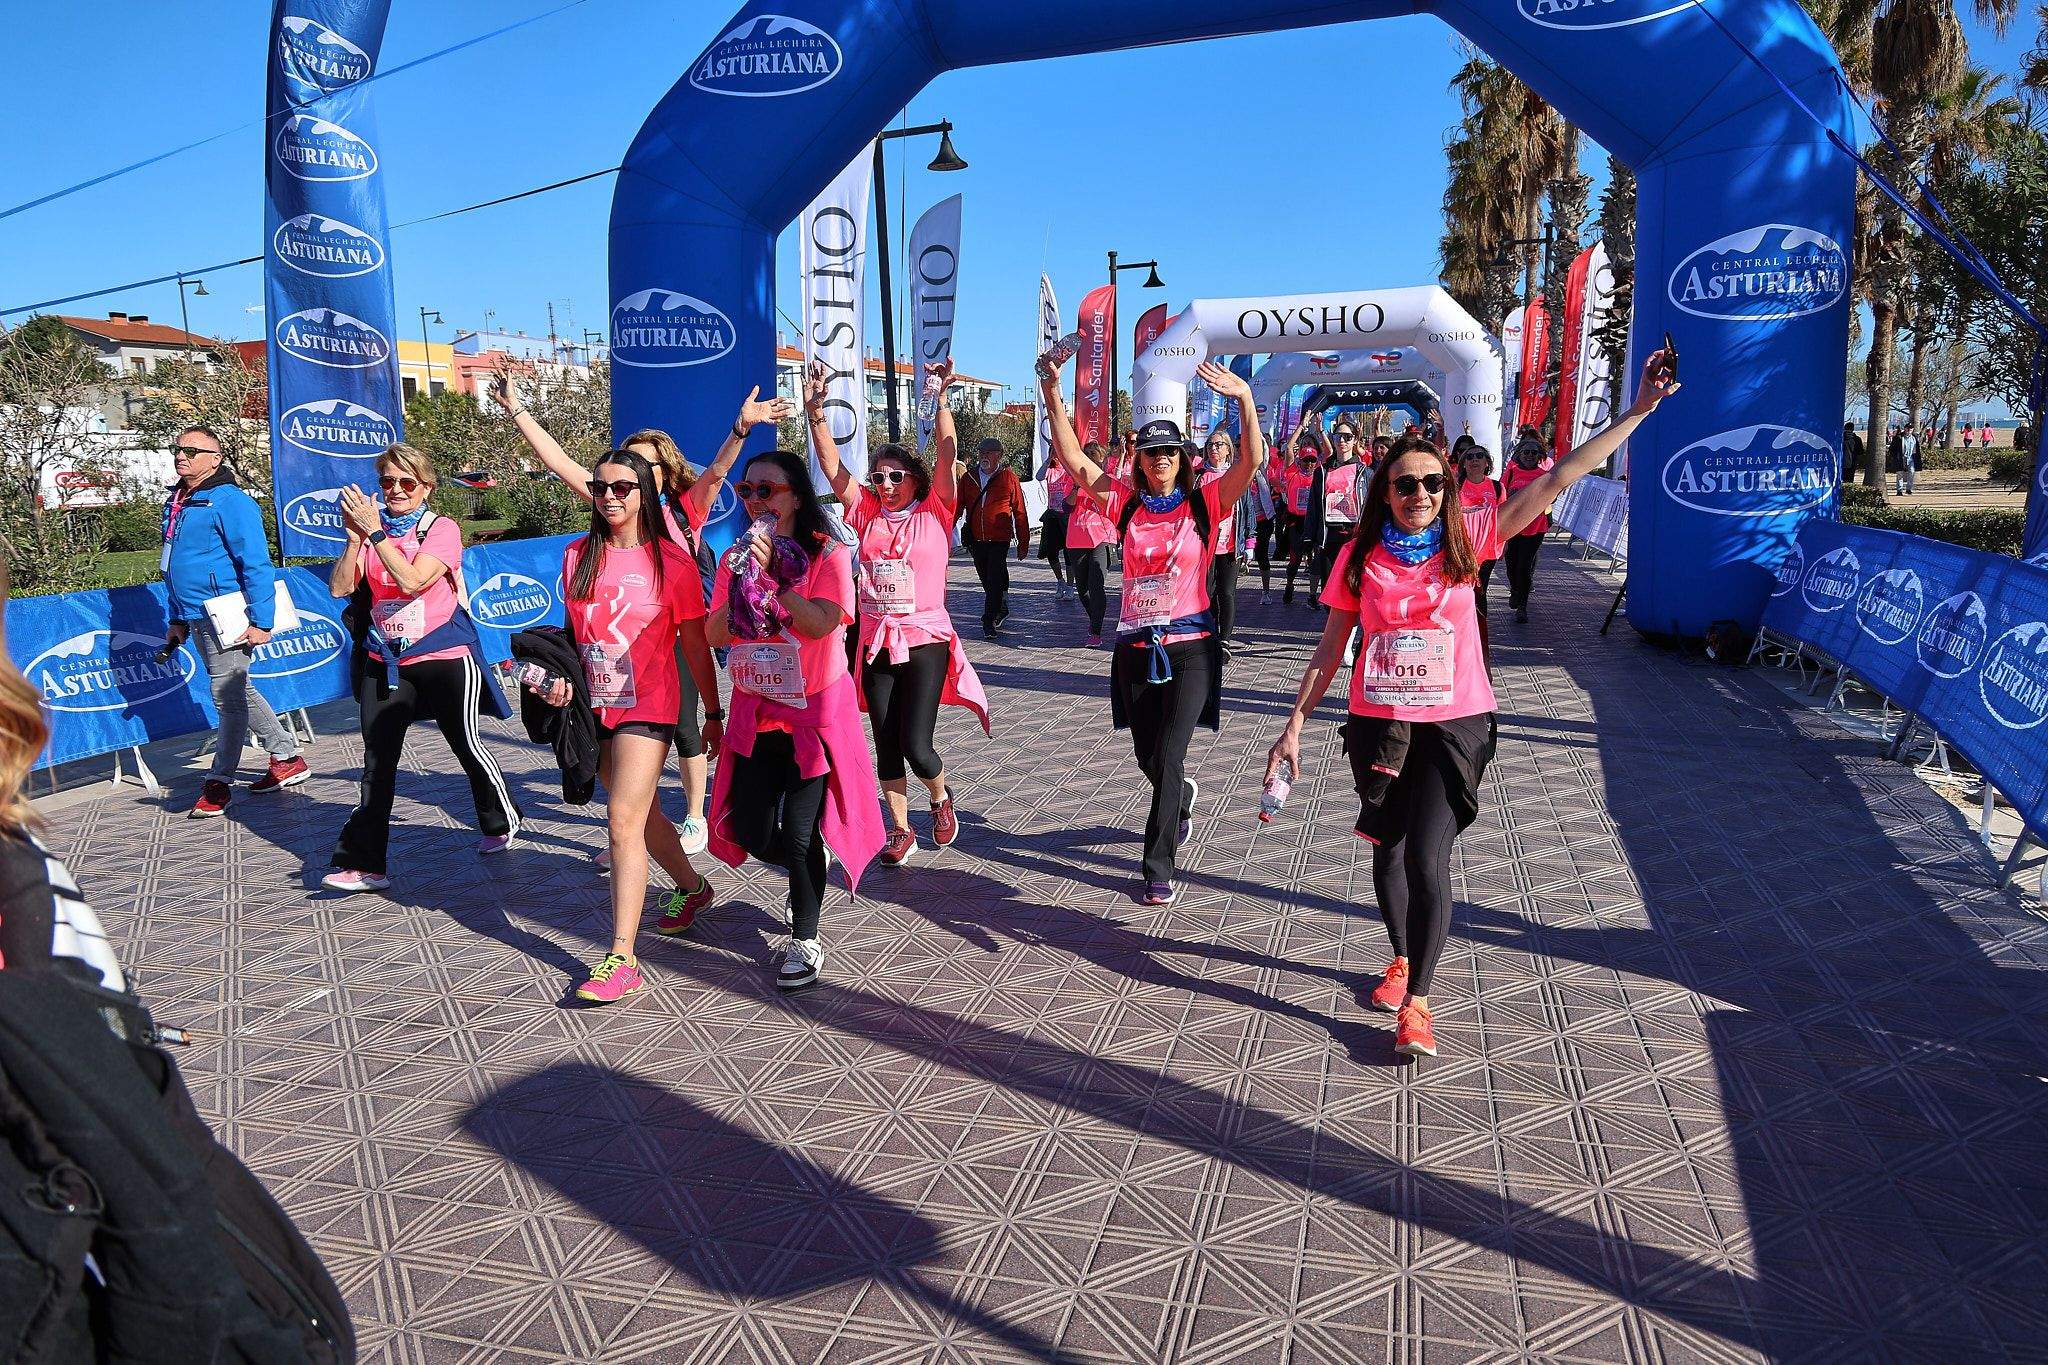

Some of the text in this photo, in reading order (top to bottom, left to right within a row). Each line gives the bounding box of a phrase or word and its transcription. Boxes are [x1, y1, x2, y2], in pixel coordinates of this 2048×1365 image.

[720, 39, 823, 55] CENTRAL LECHERA
[696, 51, 830, 82] ASTURIANA
[281, 135, 370, 171] ASTURIANA
[316, 139, 363, 152] LECHERA
[292, 232, 368, 246] CENTRAL LECHERA
[280, 231, 374, 265] ASTURIANA
[1711, 255, 1839, 271] CENTRAL LECHERA
[1680, 266, 1841, 302] ASTURIANA
[918, 244, 956, 360] SHO
[622, 316, 720, 326] CENTRAL LECHERA
[1238, 302, 1385, 339] OYSHO
[302, 324, 376, 340] CENTRAL LECHERA
[612, 319, 725, 349] ASTURIANA
[1428, 331, 1475, 343] OYSHO
[284, 324, 383, 358] ASTURIANA
[1088, 308, 1104, 387] Santander
[1529, 315, 1544, 382] Santander
[1154, 346, 1196, 357] OYSHO
[1335, 388, 1401, 398] VOLVO
[1453, 393, 1496, 406] OYSHO
[1136, 404, 1174, 415] OYSHO
[306, 416, 387, 430] CENTRAL LECHERA
[288, 416, 389, 447] ASTURIANA
[1704, 453, 1829, 466] CENTRAL LECHERA
[1674, 459, 1831, 493] ASTURIANA
[312, 504, 340, 513] CENTR
[876, 583, 896, 593] 016
[479, 593, 548, 621] ASTURIANA
[1137, 598, 1157, 608] 016
[385, 622, 404, 632] 016
[59, 650, 159, 672] CENTRAL LECHE
[1394, 664, 1428, 677] 016
[40, 658, 188, 701] ASTURIANA
[754, 673, 783, 685] 016
